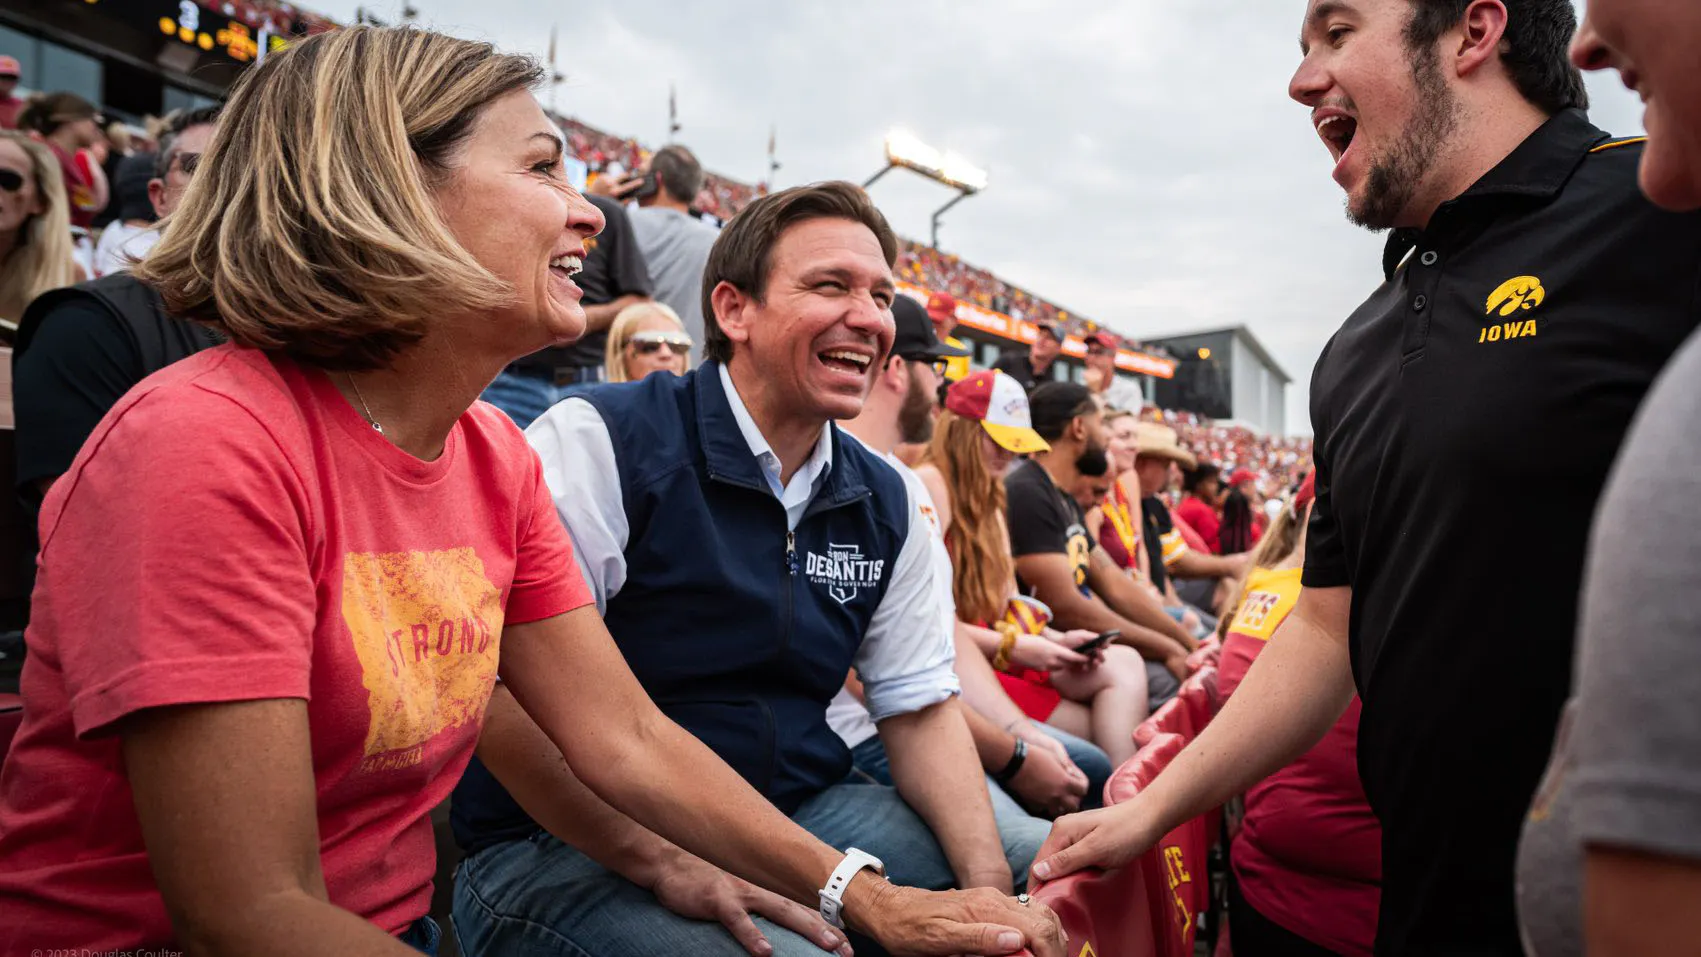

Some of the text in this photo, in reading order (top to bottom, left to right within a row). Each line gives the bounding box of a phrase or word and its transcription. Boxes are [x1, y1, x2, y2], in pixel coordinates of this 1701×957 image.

[1479, 319, 1537, 343] IOWA
[833, 551, 849, 561] RON
[806, 551, 884, 581] DESANTIS
[810, 576, 836, 585] FLORIDA
